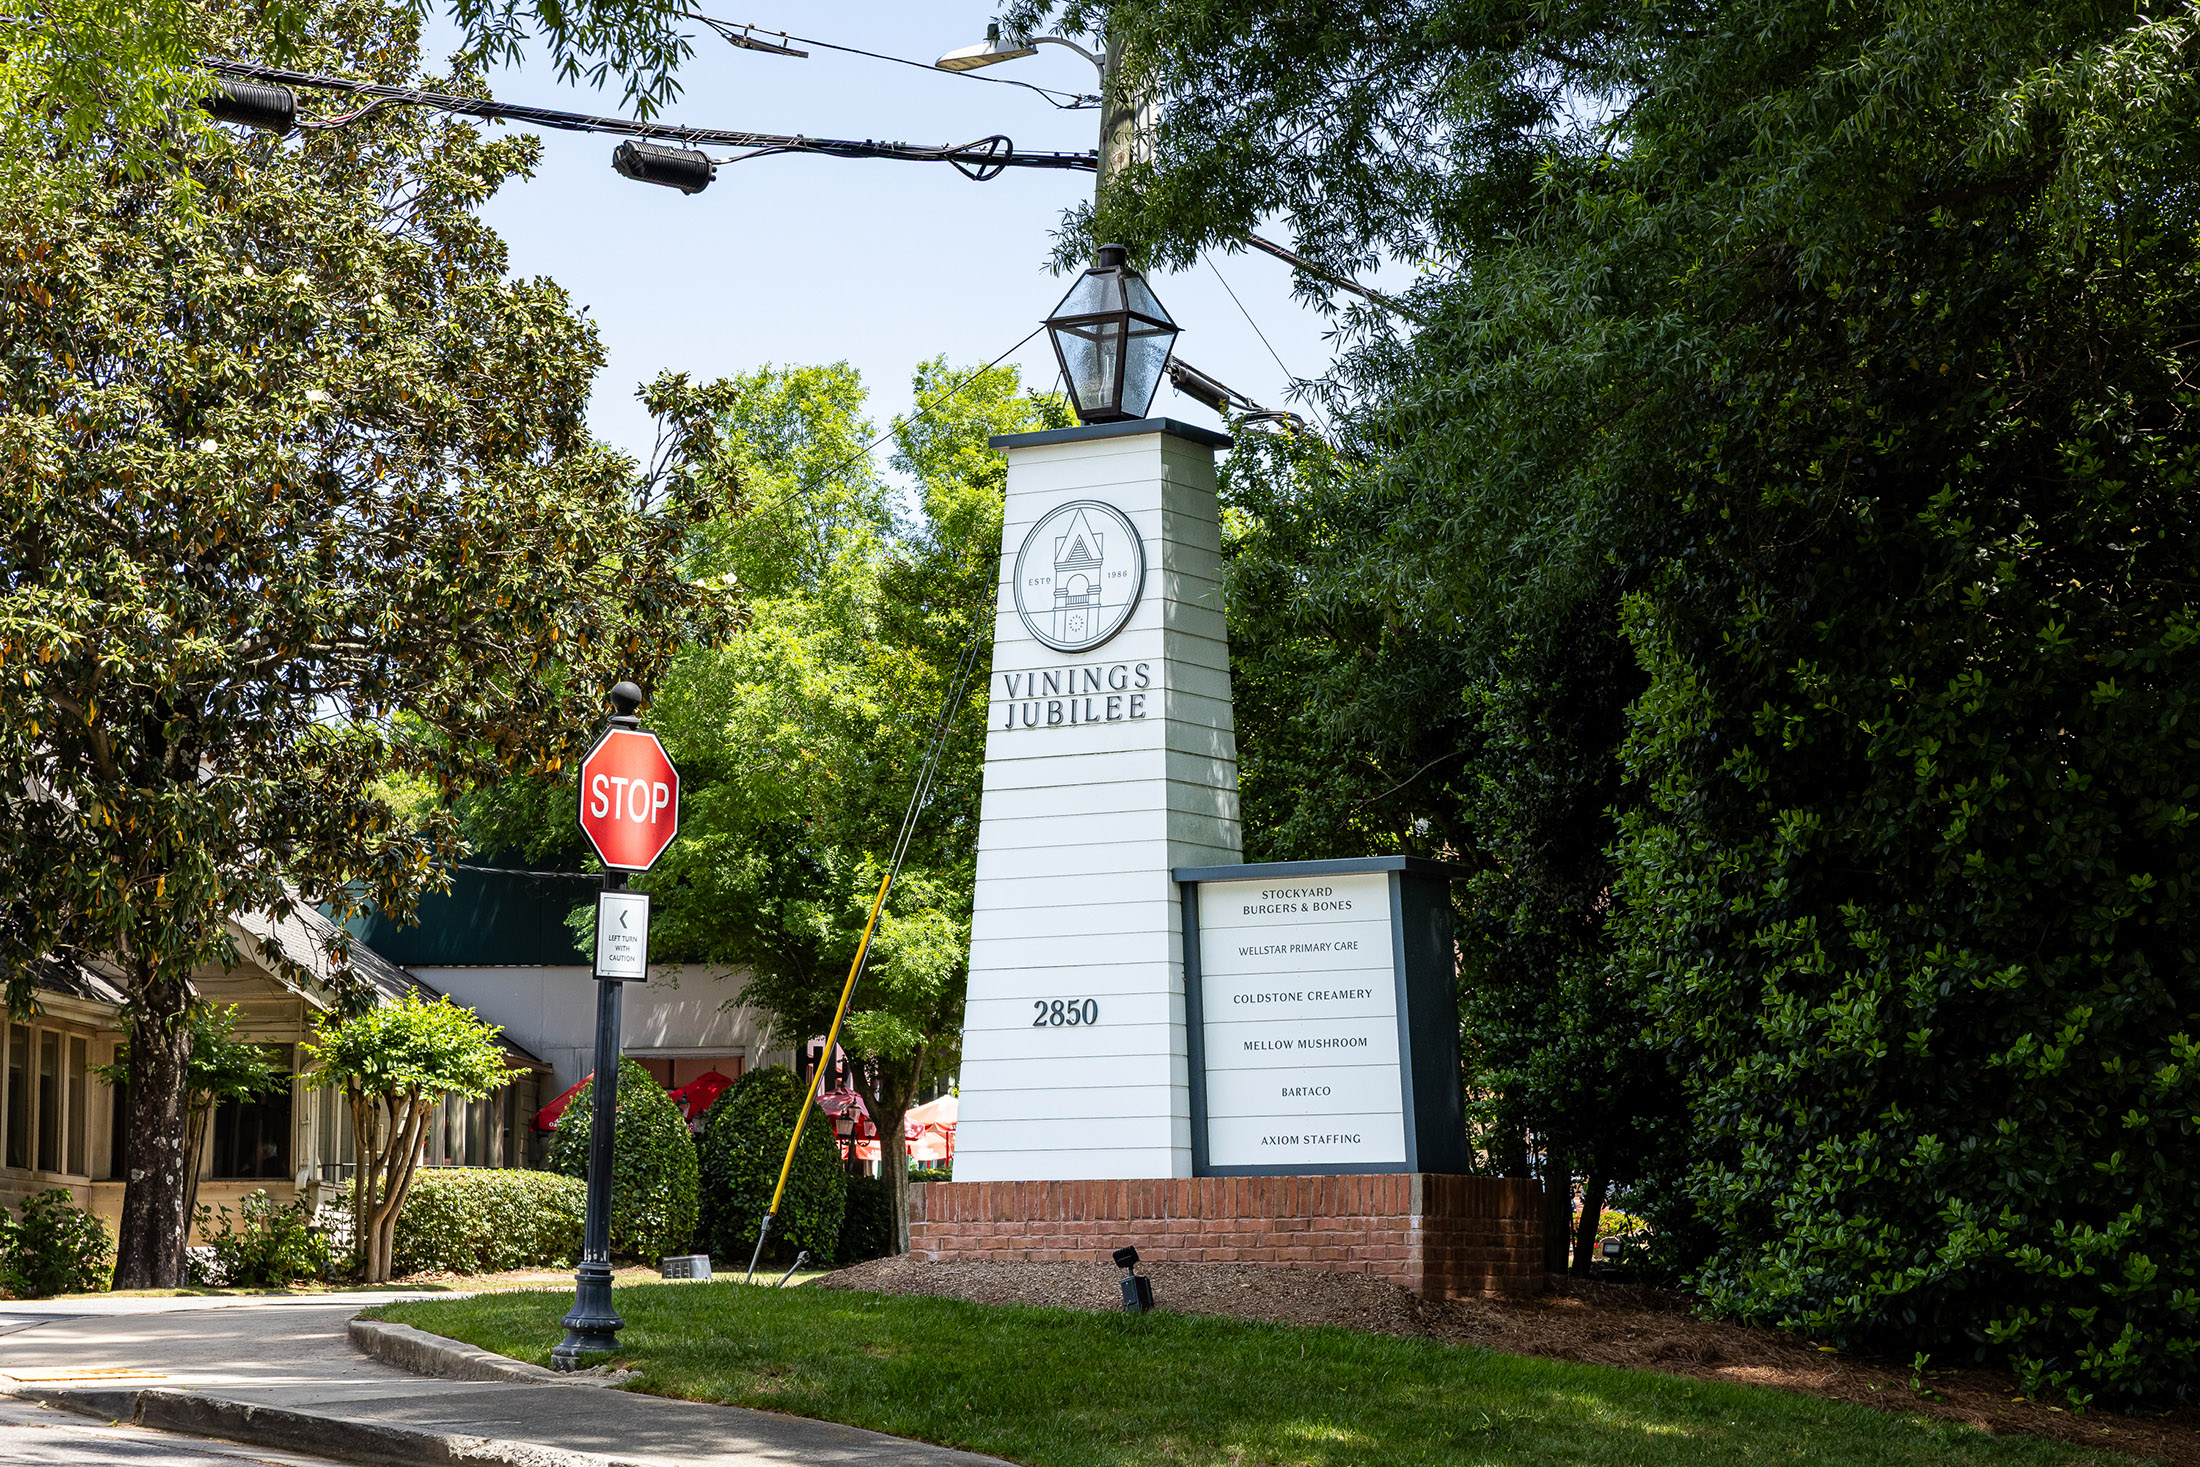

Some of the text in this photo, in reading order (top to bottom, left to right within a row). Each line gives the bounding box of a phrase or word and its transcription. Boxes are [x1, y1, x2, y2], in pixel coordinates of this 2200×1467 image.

[1107, 570, 1128, 579] 1986
[1004, 663, 1150, 698] VININGS
[1005, 694, 1146, 729] JUBILEE
[591, 774, 669, 824] STOP
[1262, 887, 1333, 900] STOCKYARD
[1243, 900, 1352, 915] BURGERS & BONES
[608, 934, 638, 943] LEFT TURN
[1238, 940, 1359, 956] WELLSTAR PRIMARY CARE
[608, 954, 636, 962] CAUTION
[1233, 989, 1373, 1004] COLDSTONE CREAMERY
[1032, 998, 1099, 1027] 2850
[1243, 1037, 1368, 1051] MELLOW MUSHROOM
[1281, 1086, 1331, 1097] BARTACO
[1261, 1133, 1361, 1146] AXIOM STAFFING
